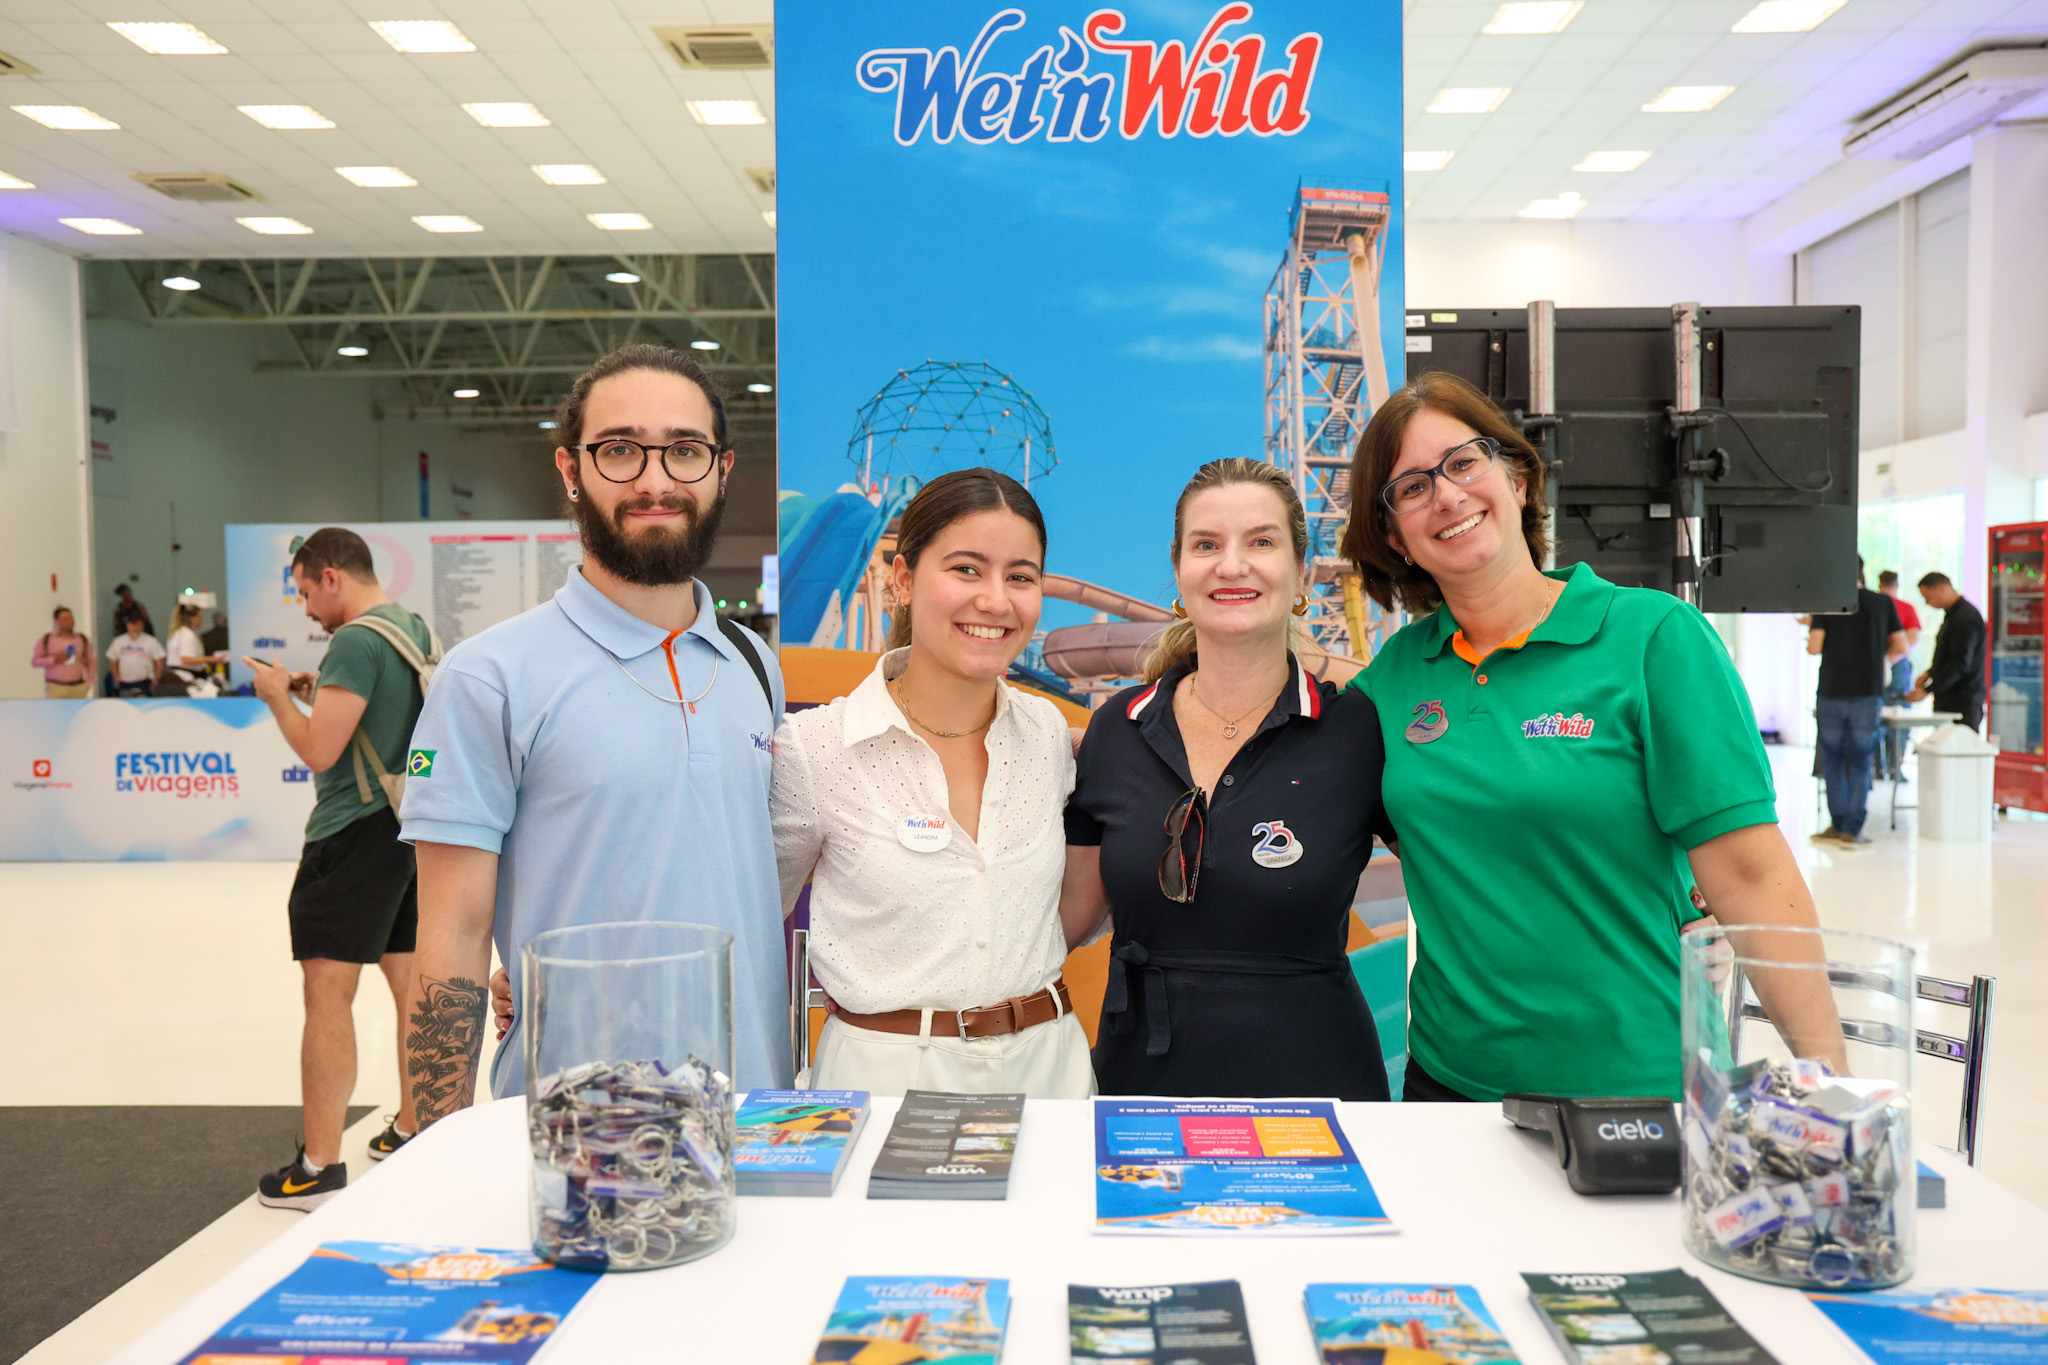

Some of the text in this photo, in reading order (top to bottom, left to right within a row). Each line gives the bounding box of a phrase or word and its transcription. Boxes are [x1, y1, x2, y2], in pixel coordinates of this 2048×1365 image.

[1554, 712, 1595, 739] Wild
[115, 752, 236, 776] FESTIVAL
[134, 775, 240, 798] viagens
[924, 816, 946, 829] Wild
[1252, 820, 1293, 854] 25
[1598, 1118, 1664, 1140] cielo
